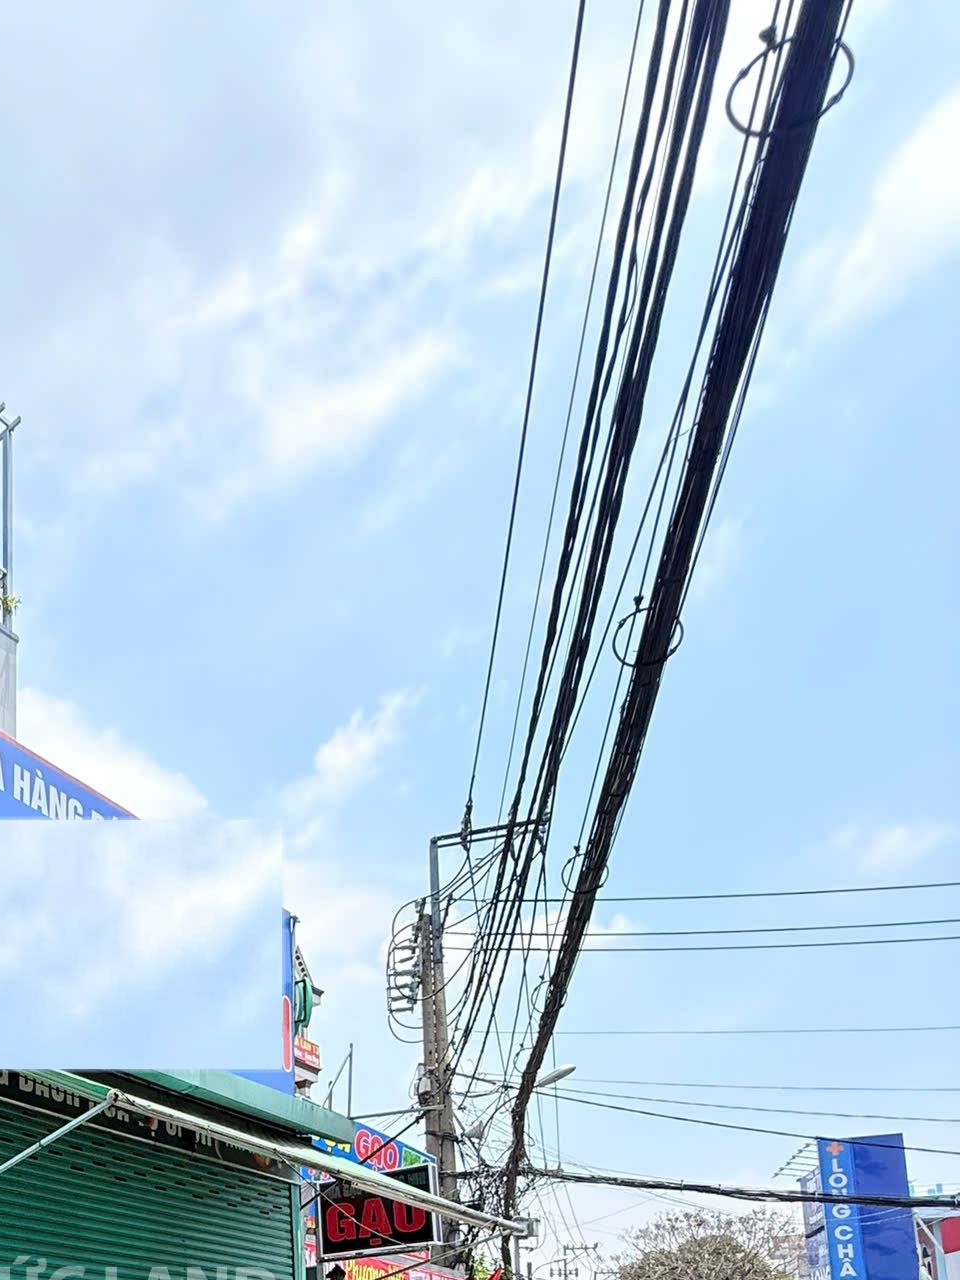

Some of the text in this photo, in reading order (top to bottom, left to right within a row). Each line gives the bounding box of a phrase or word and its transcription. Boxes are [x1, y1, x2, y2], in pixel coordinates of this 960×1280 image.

[13, 768, 84, 821] HÀNG
[354, 1129, 400, 1174] GẠO
[326, 1197, 427, 1246] GẠO
